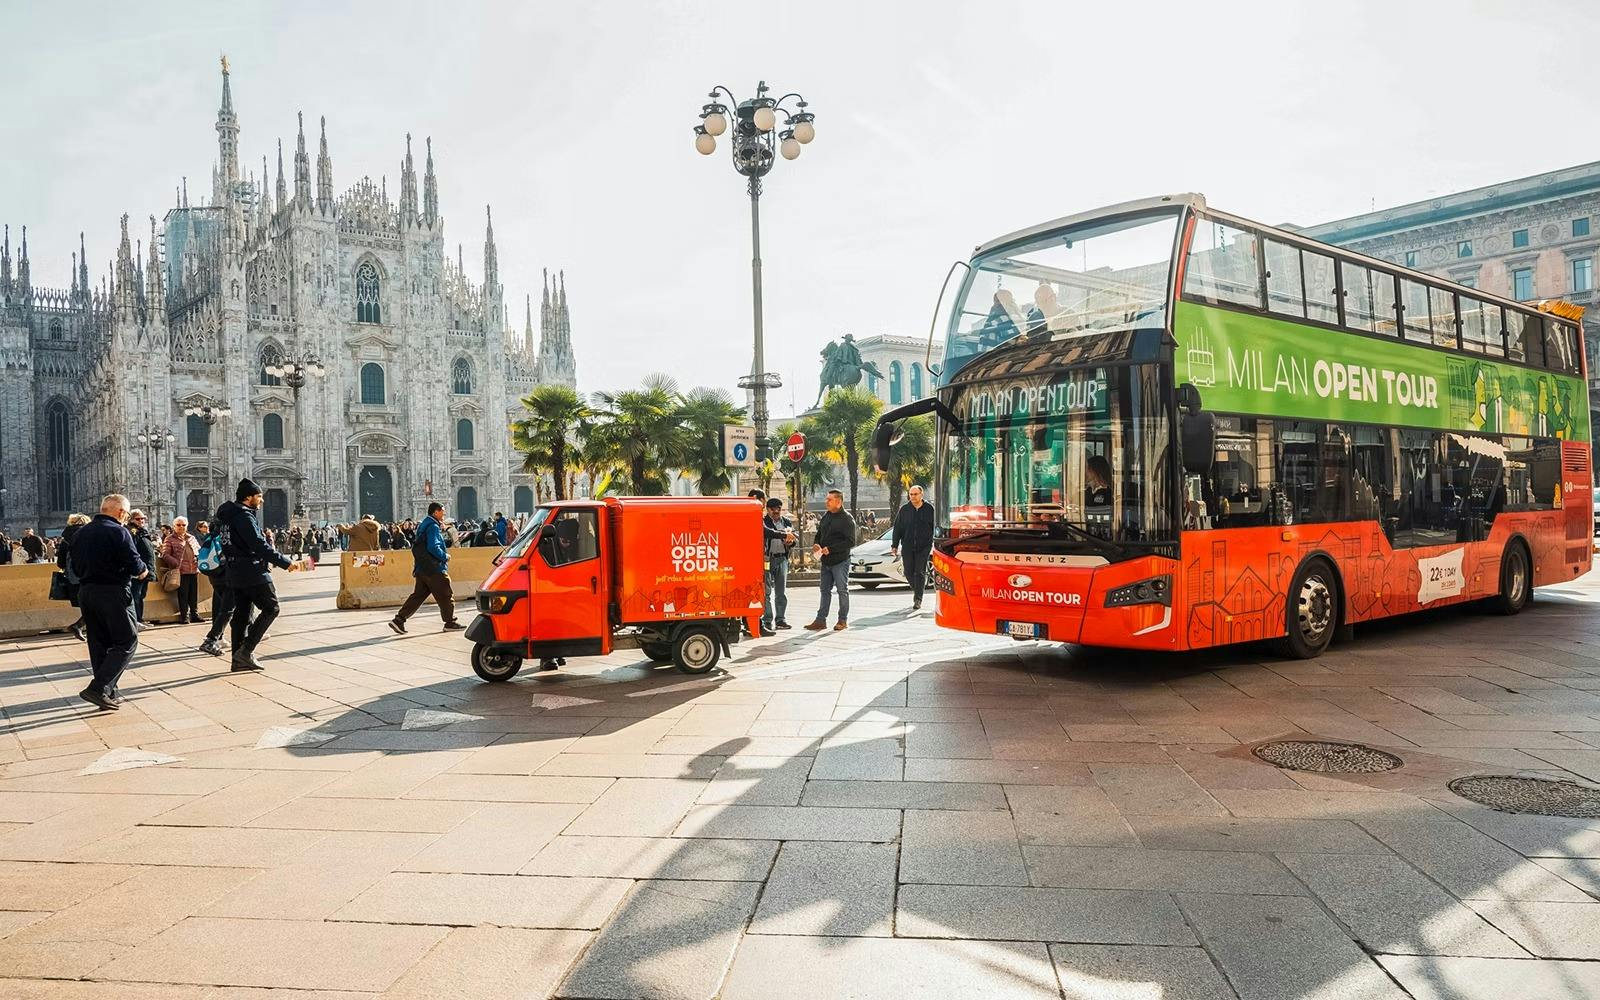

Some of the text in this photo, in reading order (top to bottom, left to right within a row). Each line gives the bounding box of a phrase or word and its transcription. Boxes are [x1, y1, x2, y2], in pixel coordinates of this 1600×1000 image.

[1227, 346, 1438, 409] MILAN OPEN TOUR
[971, 389, 1014, 418] MILAN
[671, 532, 719, 546] MILAN
[671, 546, 719, 559] OPEN
[671, 559, 719, 573] TOUR
[981, 587, 1081, 605] MILAN OPEN TOUR
